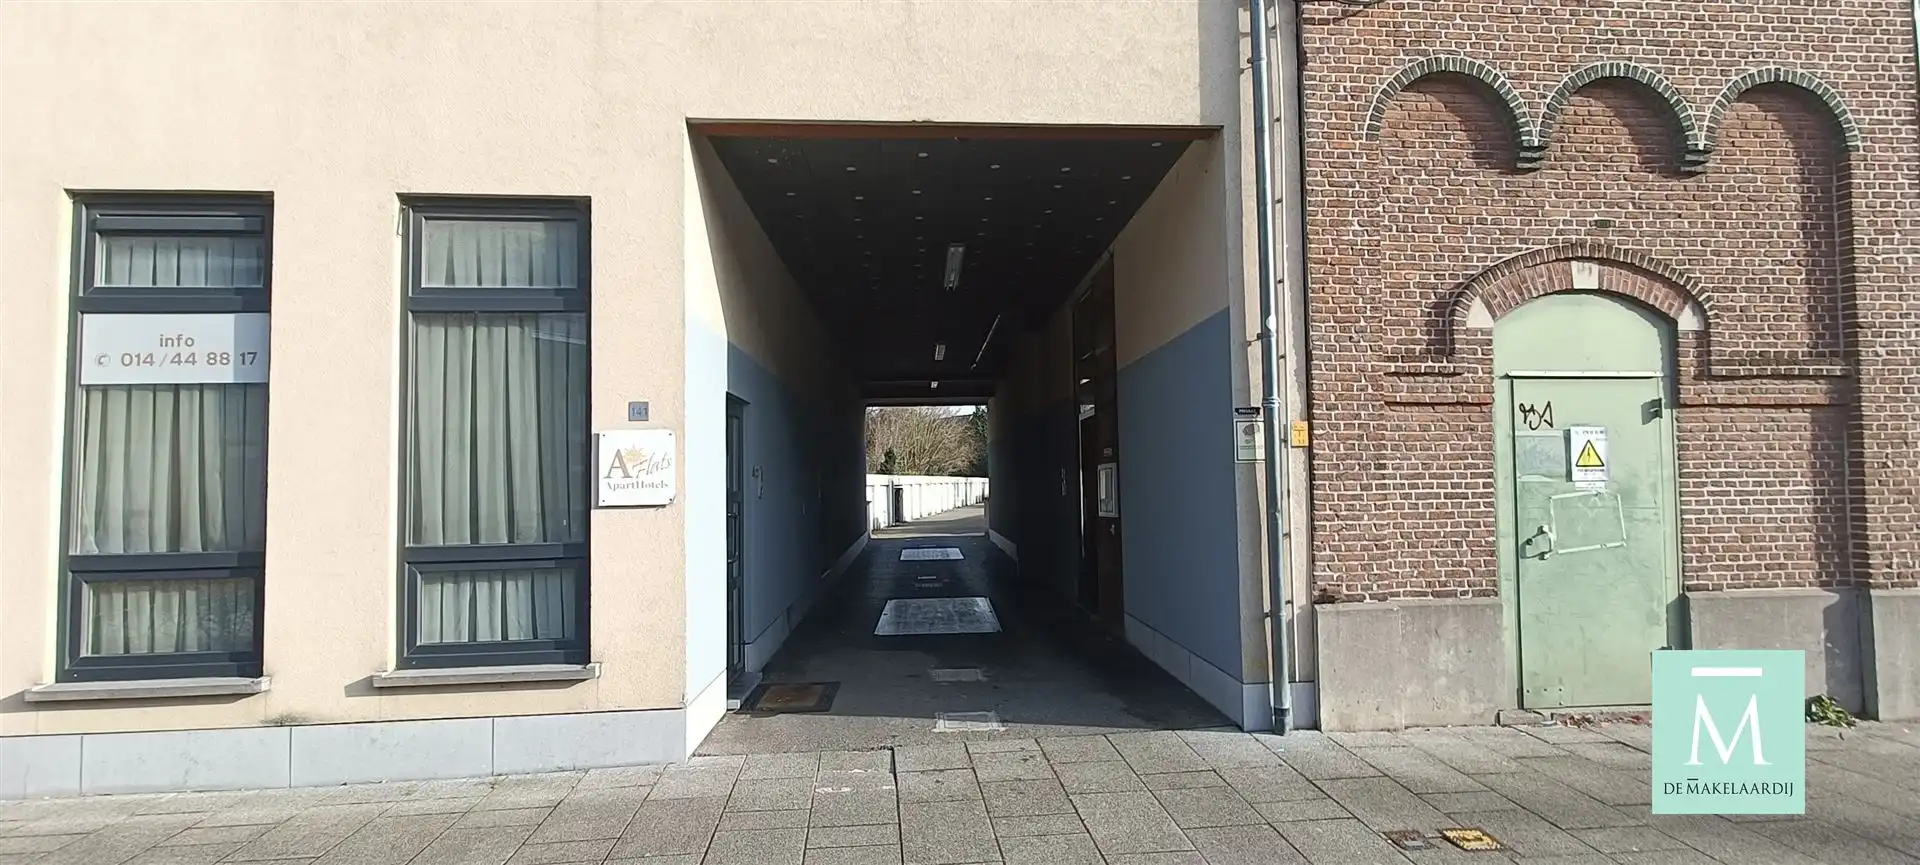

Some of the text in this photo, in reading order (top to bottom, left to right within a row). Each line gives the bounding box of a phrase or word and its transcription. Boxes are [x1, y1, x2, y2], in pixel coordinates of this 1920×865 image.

[159, 333, 195, 347] info
[206, 351, 231, 366] 88
[239, 351, 258, 366] 17
[607, 480, 669, 491] ApartHotels
